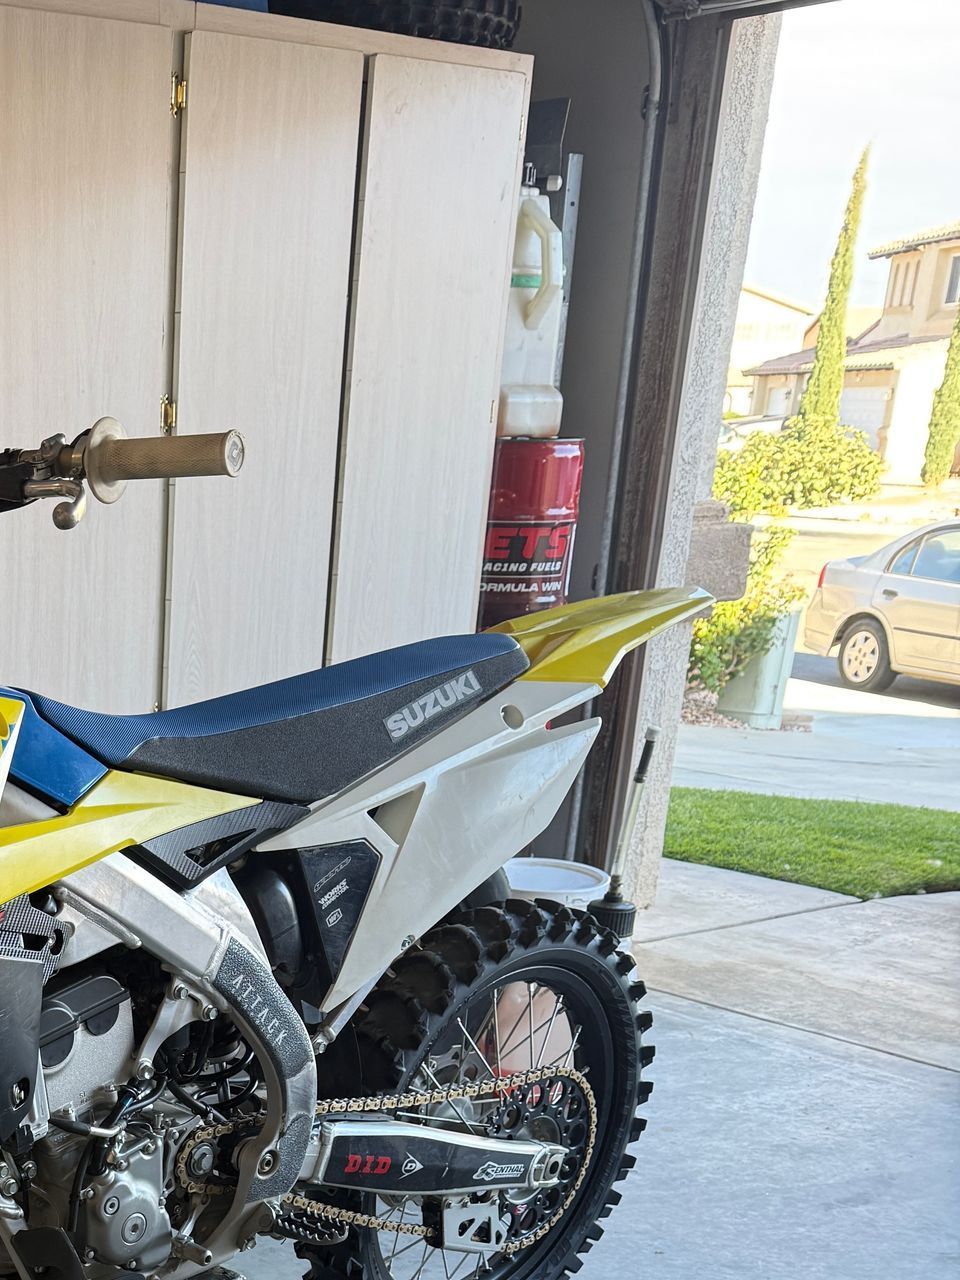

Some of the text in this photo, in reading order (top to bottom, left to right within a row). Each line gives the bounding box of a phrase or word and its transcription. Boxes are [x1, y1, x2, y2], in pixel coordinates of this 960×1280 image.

[486, 527, 570, 559] ETS
[482, 561, 562, 573] ACING FUELS
[479, 582, 539, 593] ORMULA
[387, 670, 481, 737] SUZUKI
[232, 974, 288, 1046] ATTACK
